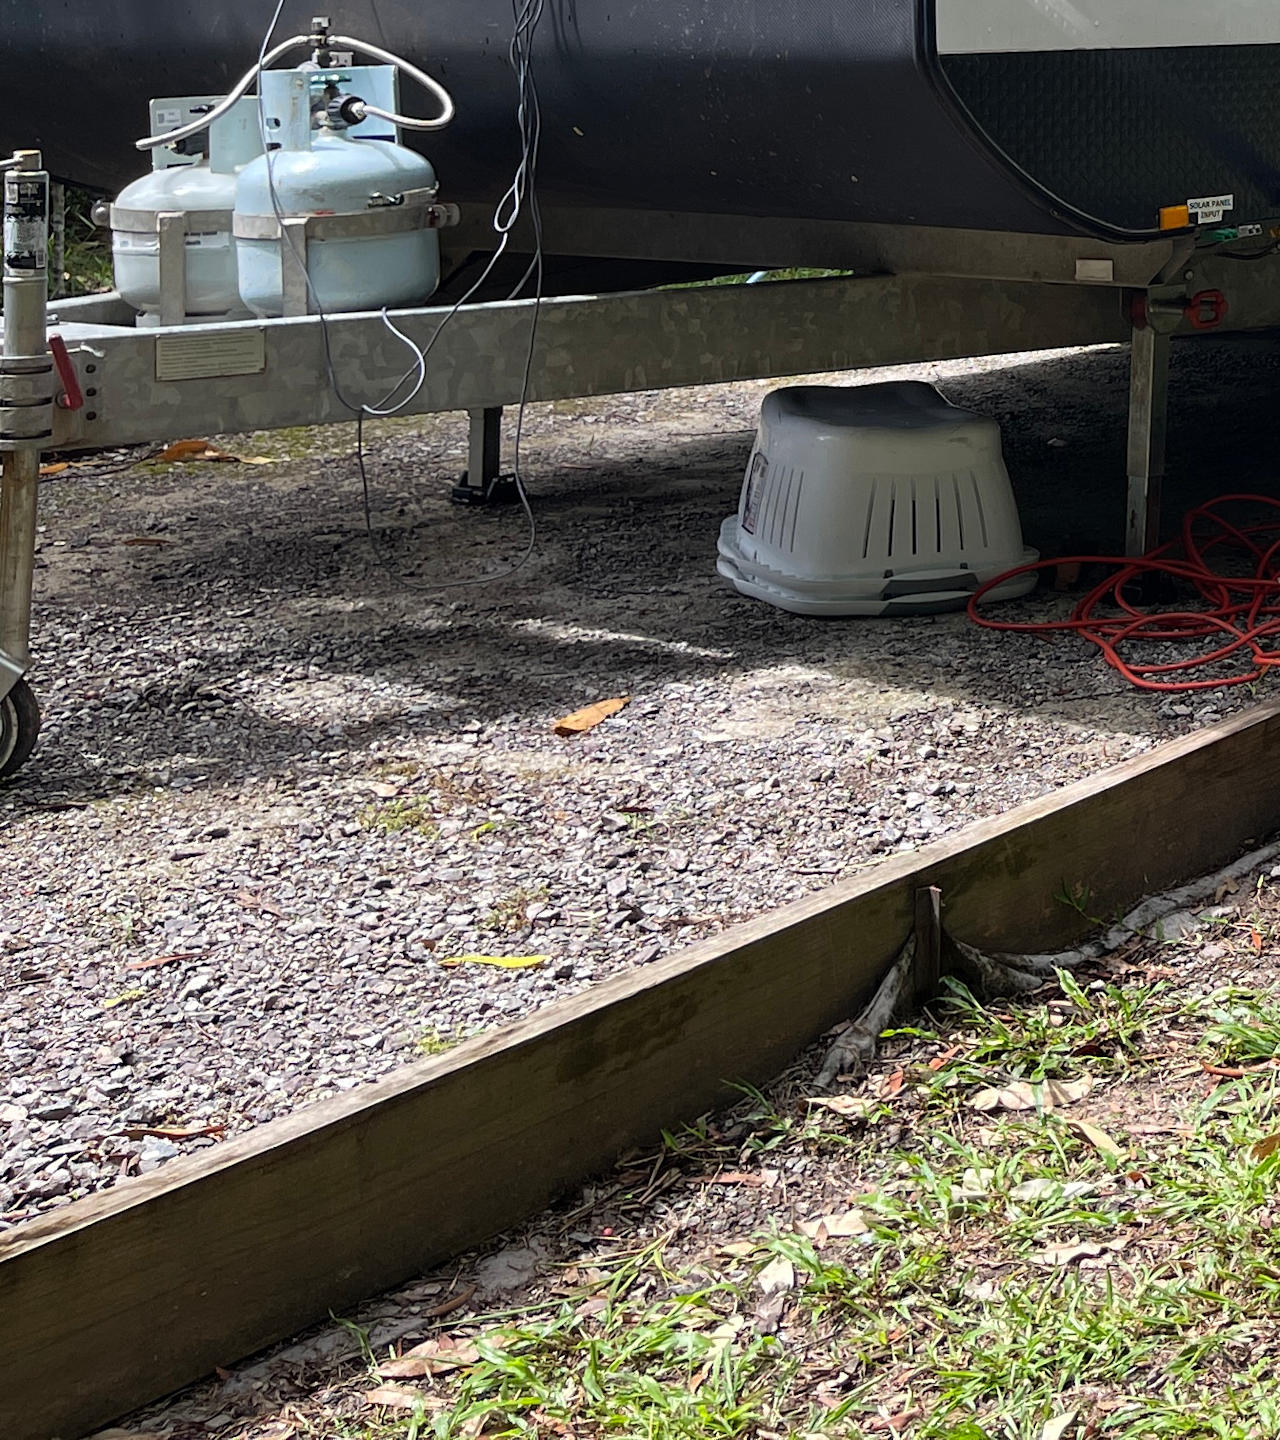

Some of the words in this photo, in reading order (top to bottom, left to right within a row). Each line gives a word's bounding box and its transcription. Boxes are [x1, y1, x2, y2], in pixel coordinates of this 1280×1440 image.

[1189, 200, 1210, 210] SOLAR
[1211, 199, 1232, 208] PANEL
[1201, 210, 1221, 219] INPUT
